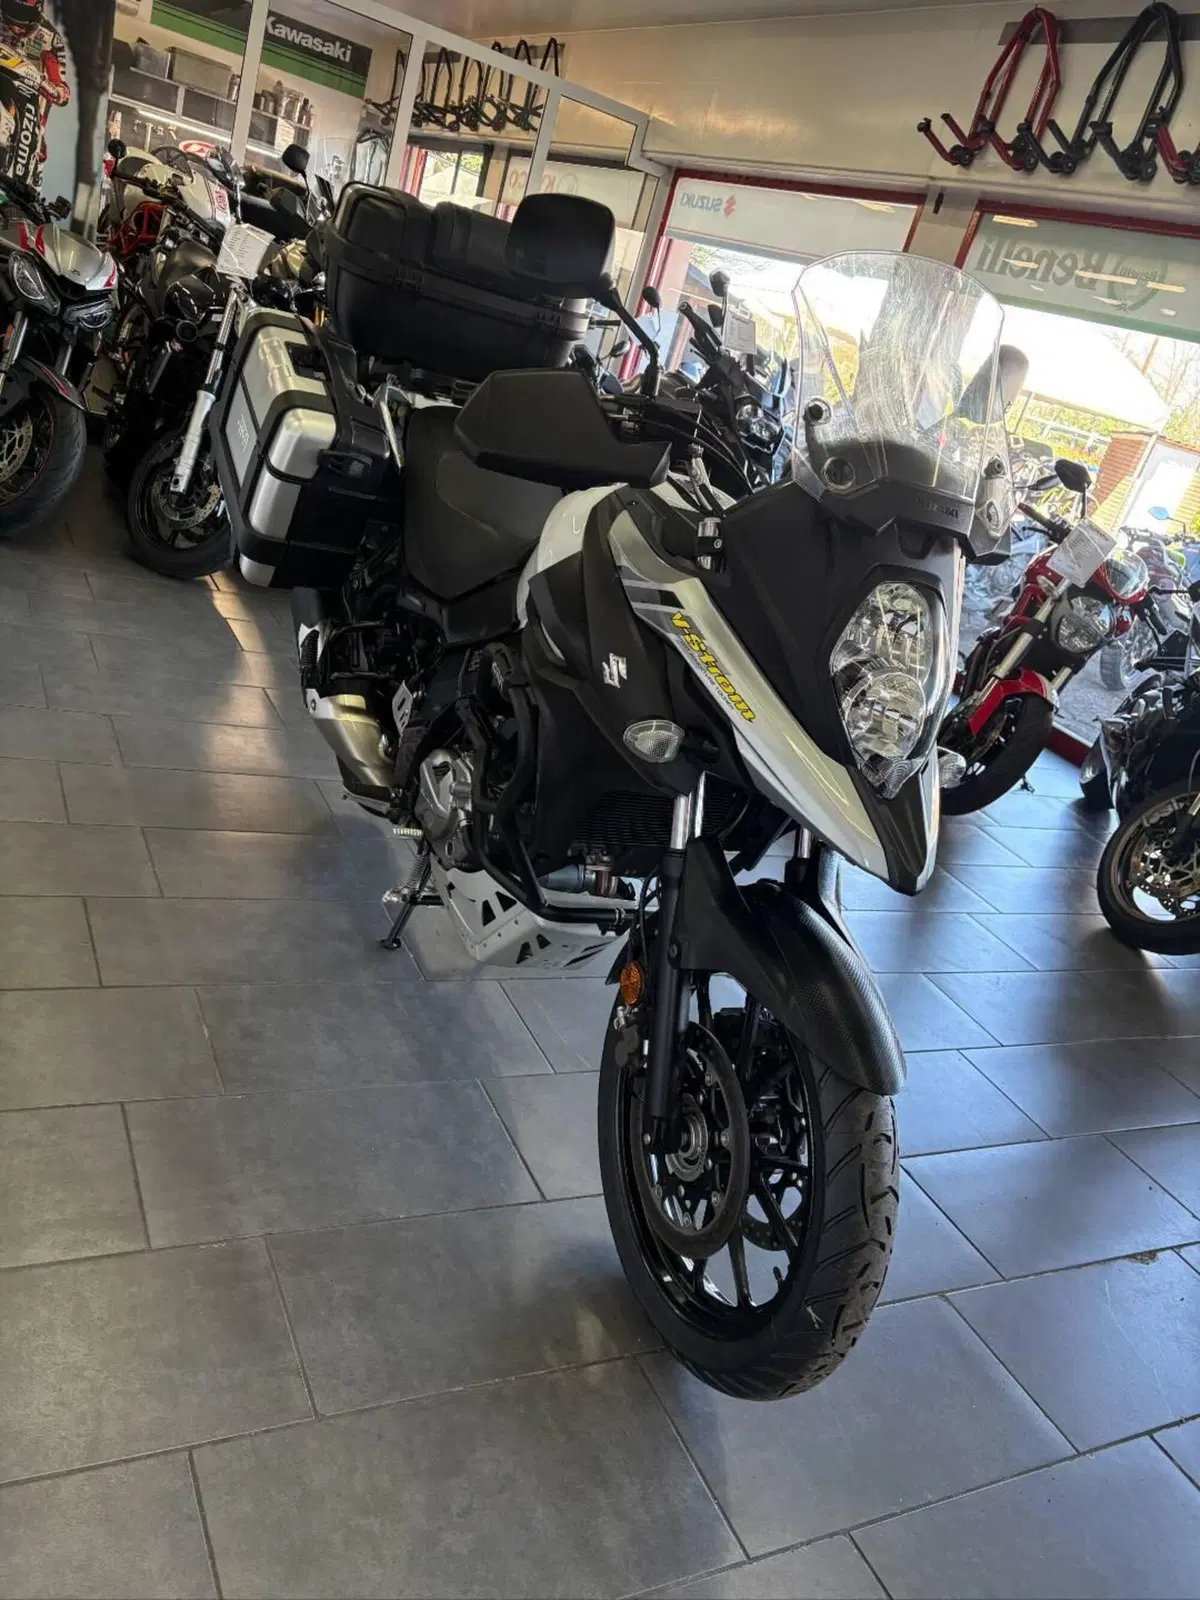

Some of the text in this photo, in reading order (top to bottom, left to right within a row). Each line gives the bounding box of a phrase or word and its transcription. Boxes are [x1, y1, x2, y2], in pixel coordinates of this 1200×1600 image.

[266, 16, 352, 63] Kawasaki
[16, 102, 37, 177] rizoma
[671, 611, 756, 723] V-Strom
